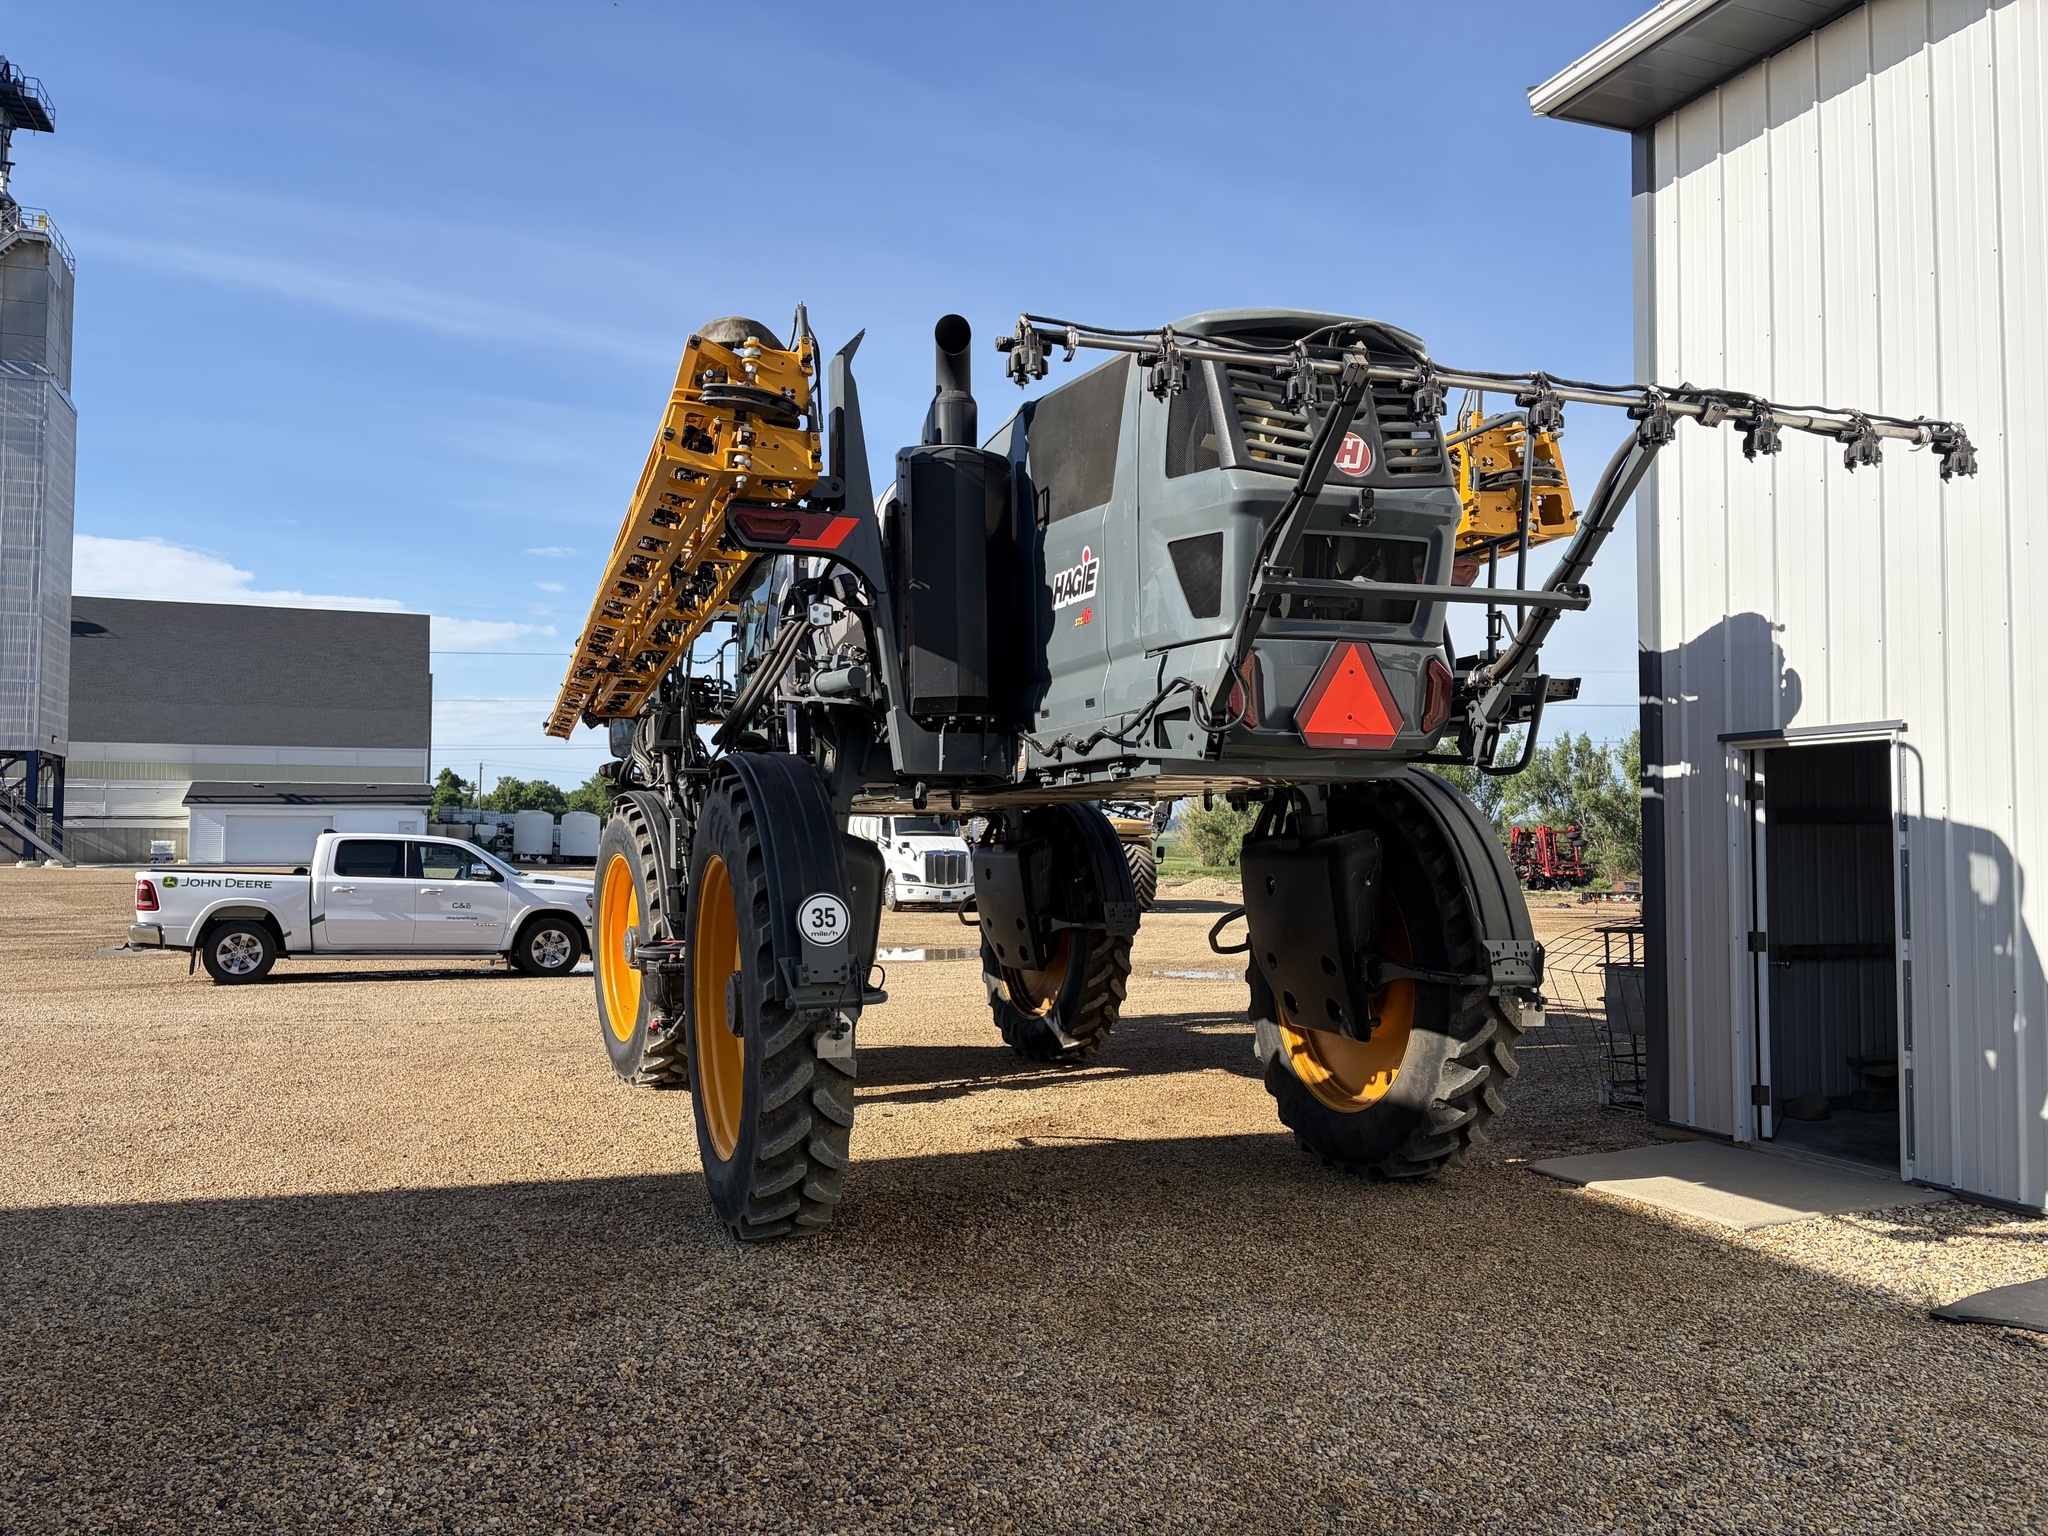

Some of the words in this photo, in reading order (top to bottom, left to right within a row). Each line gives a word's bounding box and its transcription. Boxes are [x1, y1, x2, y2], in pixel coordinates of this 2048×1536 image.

[1053, 549, 1098, 606] HAGIE
[181, 877, 221, 888] JOHN
[225, 878, 272, 889] DEERE
[811, 907, 837, 928] 35
